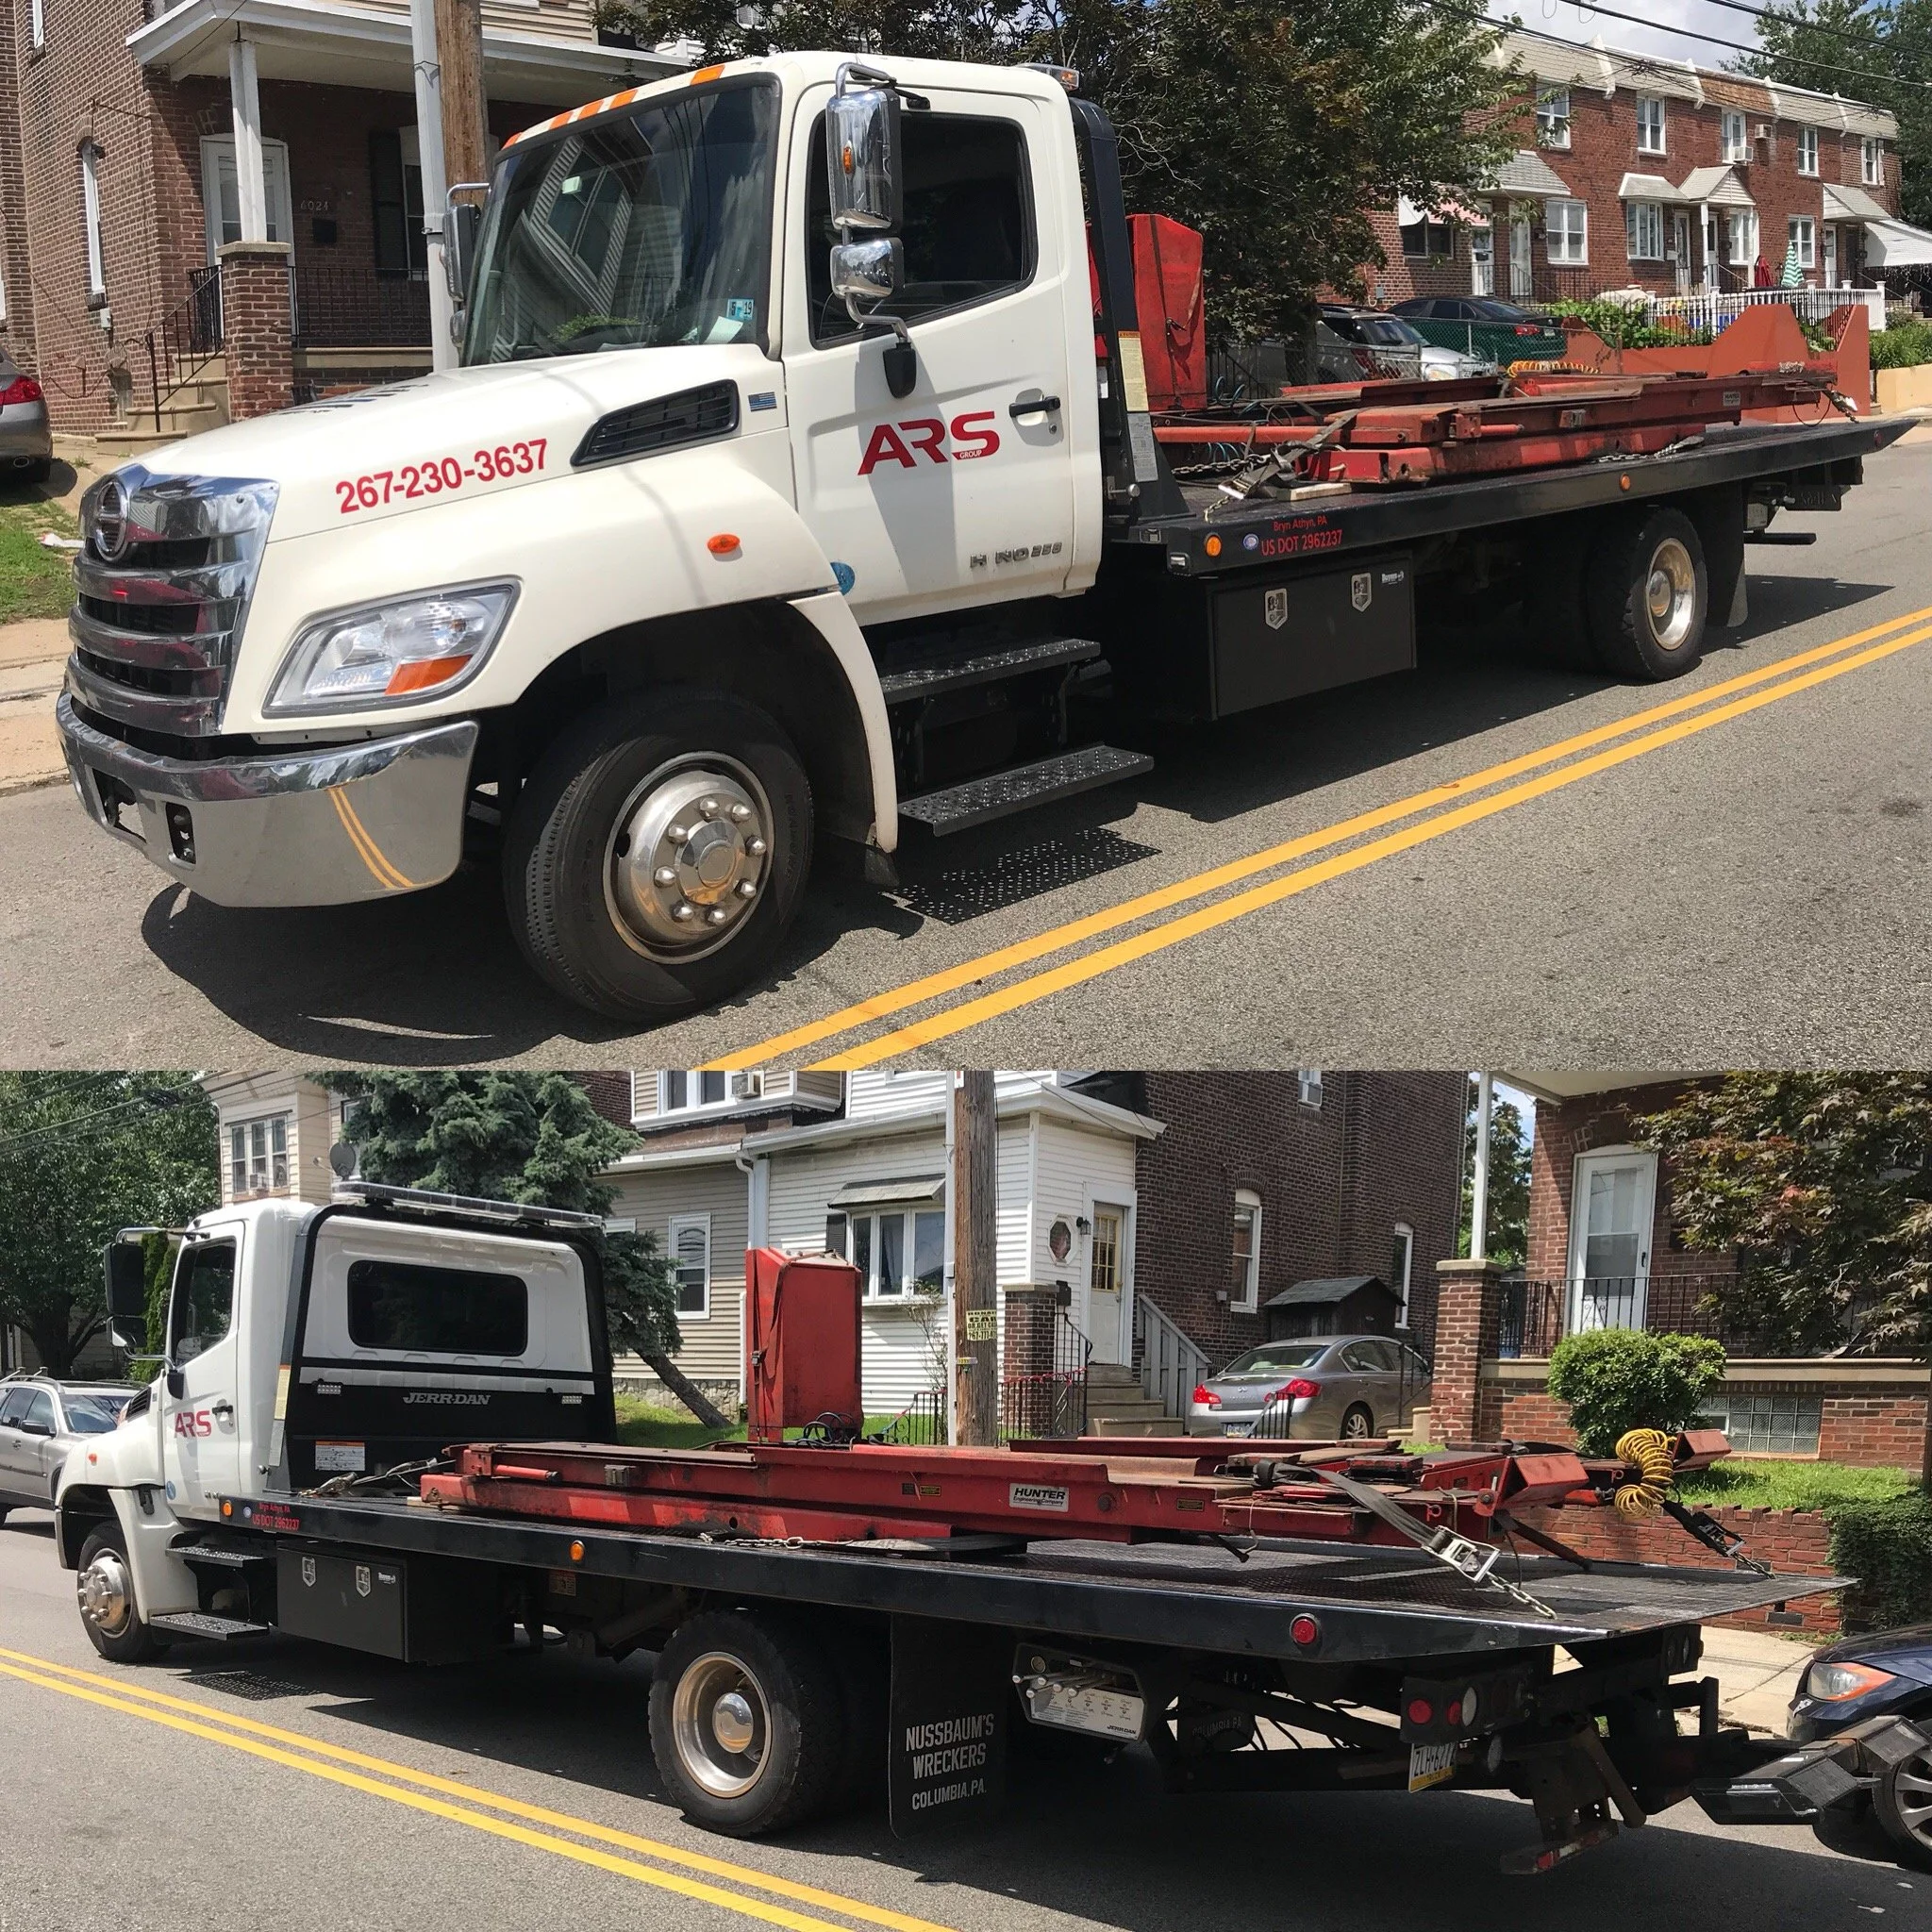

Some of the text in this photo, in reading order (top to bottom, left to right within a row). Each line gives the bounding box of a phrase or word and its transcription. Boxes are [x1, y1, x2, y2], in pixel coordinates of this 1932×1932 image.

[858, 410, 1000, 475] ARS
[959, 450, 982, 459] GROUP
[335, 438, 547, 514] 267-230-3637
[1273, 521, 1291, 532] Bryn
[1317, 515, 1327, 526] PA
[1261, 529, 1343, 556] US DOT 2962237
[175, 1410, 211, 1438] ARS
[1014, 1488, 1066, 1500] HUNTER
[252, 1513, 260, 1525] US
[260, 1514, 274, 1527] DOT
[906, 1713, 995, 1752] NUSSBAUM'S
[912, 1742, 987, 1780] WRECKERS
